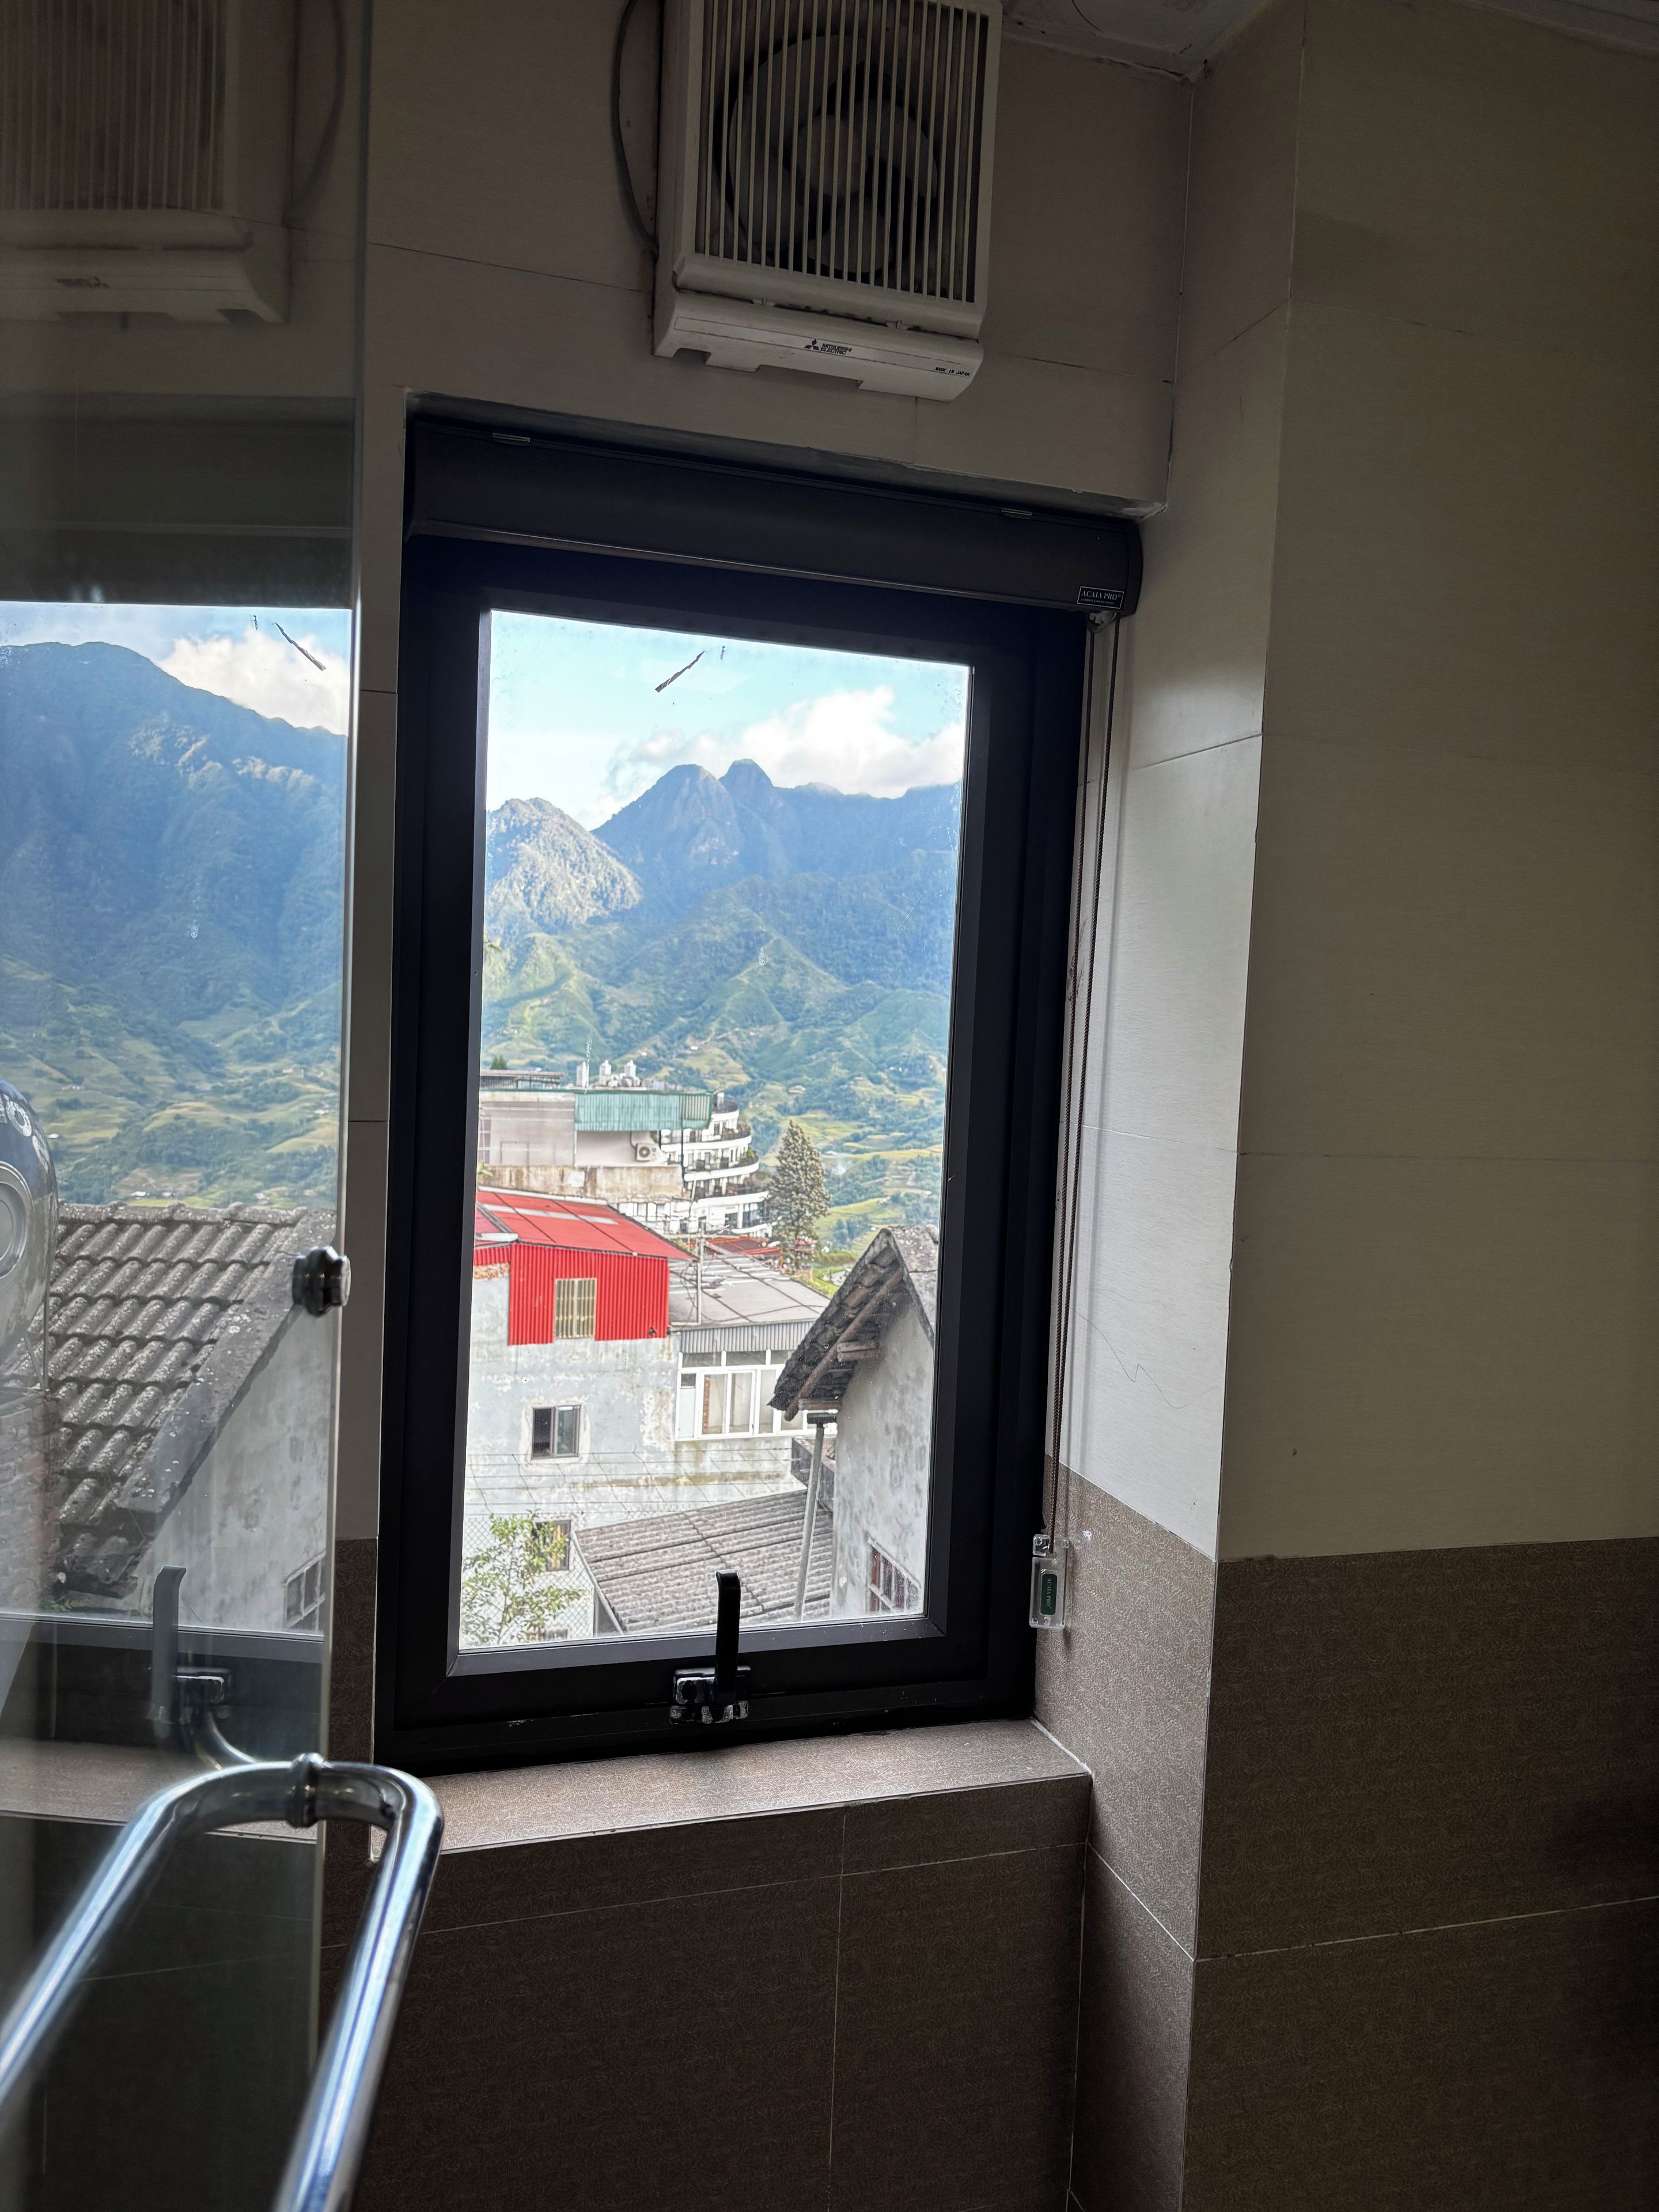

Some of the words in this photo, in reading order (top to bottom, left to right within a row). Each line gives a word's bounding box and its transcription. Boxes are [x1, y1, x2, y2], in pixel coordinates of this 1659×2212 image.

[820, 347, 846, 355] ELECTRIC
[821, 343, 853, 352] MITSUBISHI
[1081, 590, 1102, 599] ACAIA
